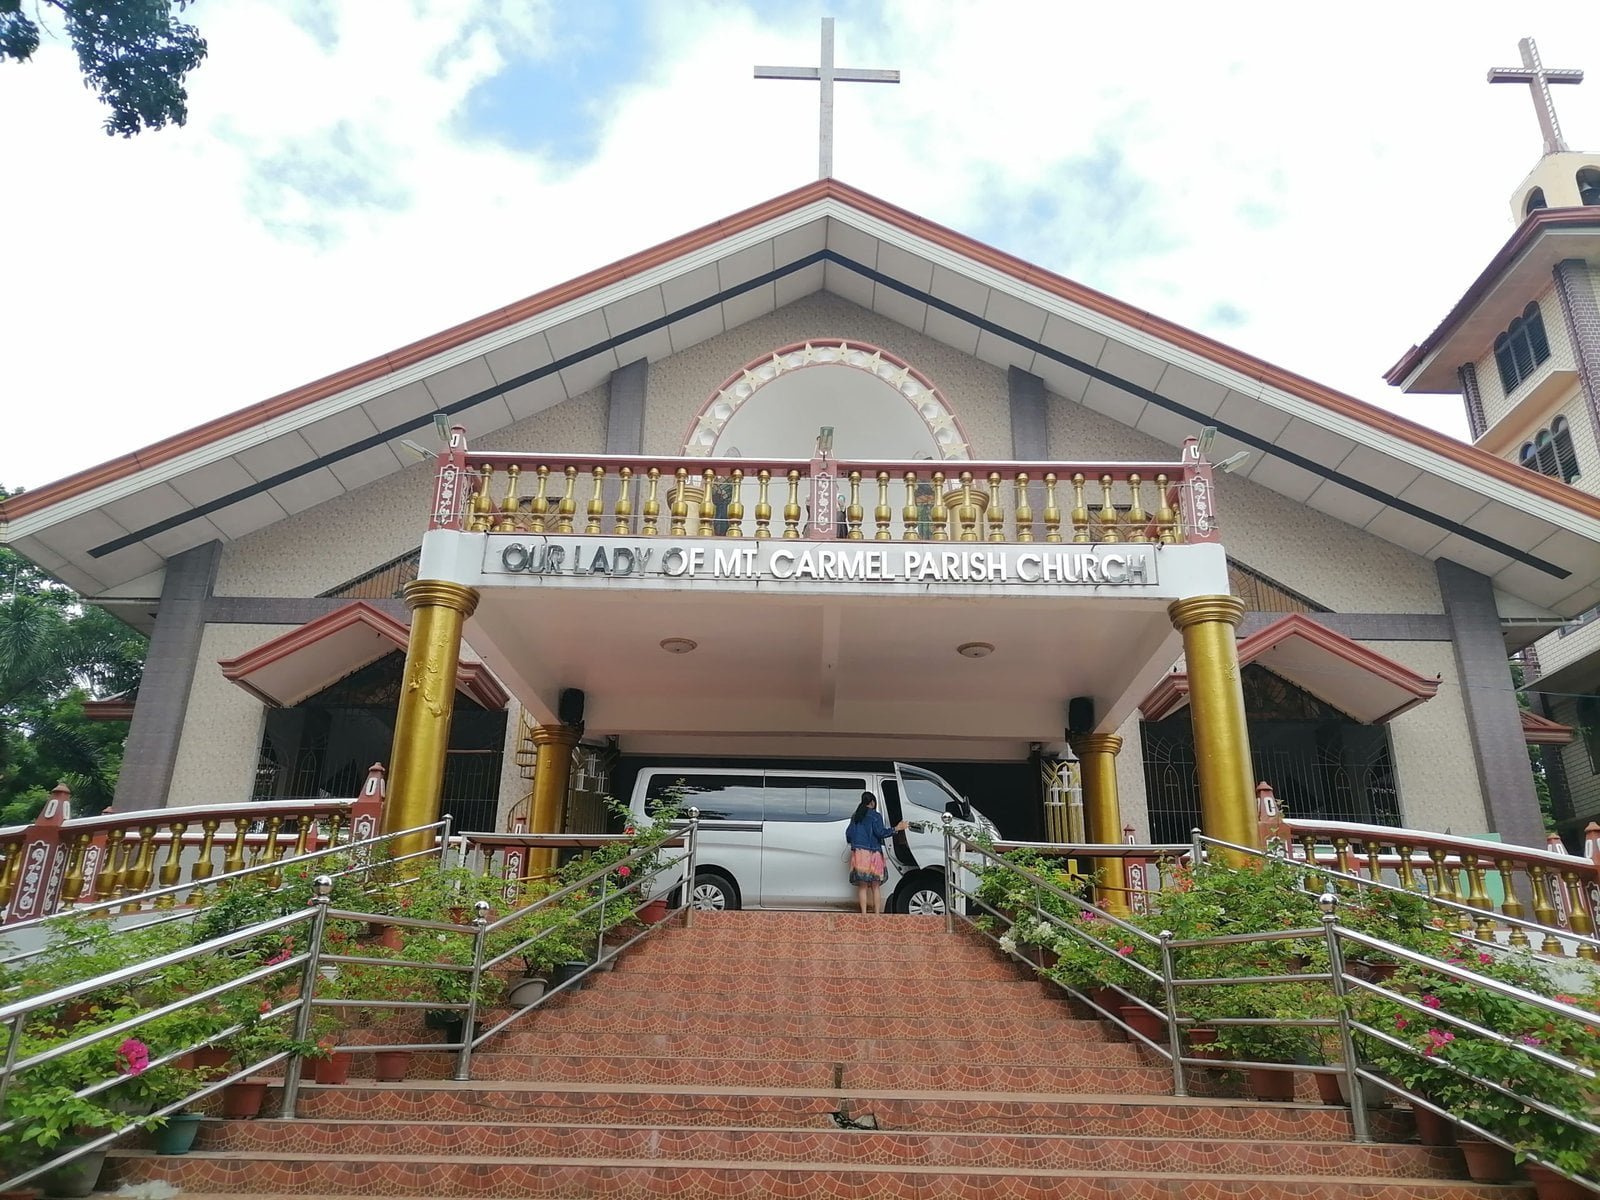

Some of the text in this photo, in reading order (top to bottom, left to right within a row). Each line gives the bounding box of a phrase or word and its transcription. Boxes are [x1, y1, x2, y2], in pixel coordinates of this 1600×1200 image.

[501, 542, 1148, 584] OUR LADY OF MT. CARMEL PARISH CHURCH
